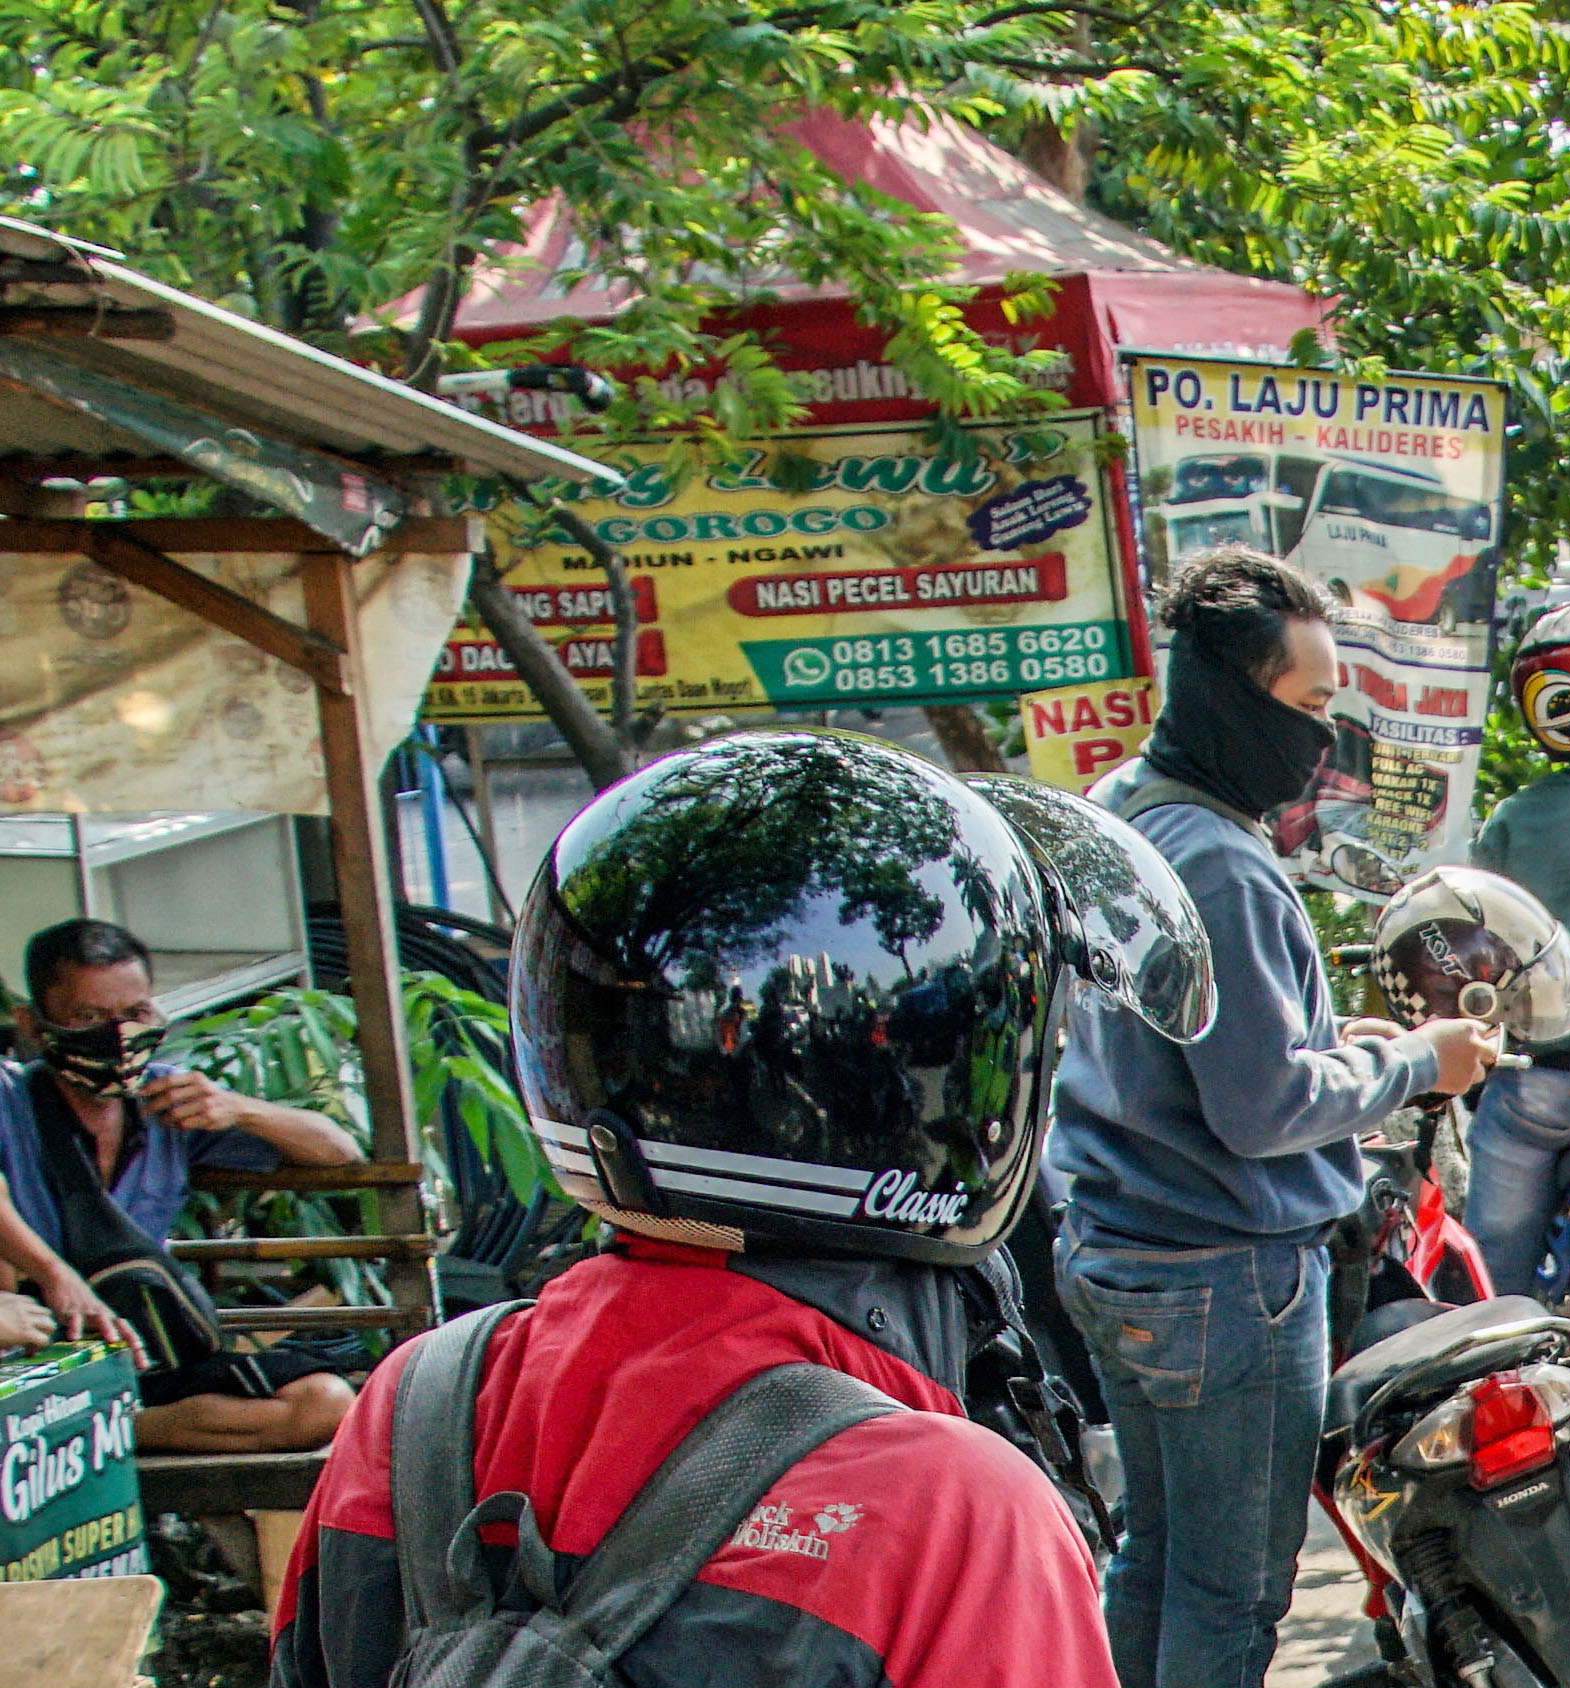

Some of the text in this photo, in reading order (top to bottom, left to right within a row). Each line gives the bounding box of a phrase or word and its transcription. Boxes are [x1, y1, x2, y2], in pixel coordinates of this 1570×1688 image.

[1145, 367, 1490, 433] PO. LAJU PRIMA
[1174, 415, 1285, 446] PESAKIH
[1316, 425, 1463, 461] KALIDERES
[727, 544, 844, 564] NGAWI
[756, 566, 1038, 608] NASI PECEL SAYURAN
[567, 643, 616, 668] AYA
[833, 626, 1106, 666] 0813 1685 6620
[834, 653, 1109, 693] 0853 1386 0580
[1031, 690, 1151, 739] NASI
[1374, 716, 1458, 745] FASILITAS
[864, 1168, 969, 1225] Classic
[2, 1434, 85, 1521] Gilus
